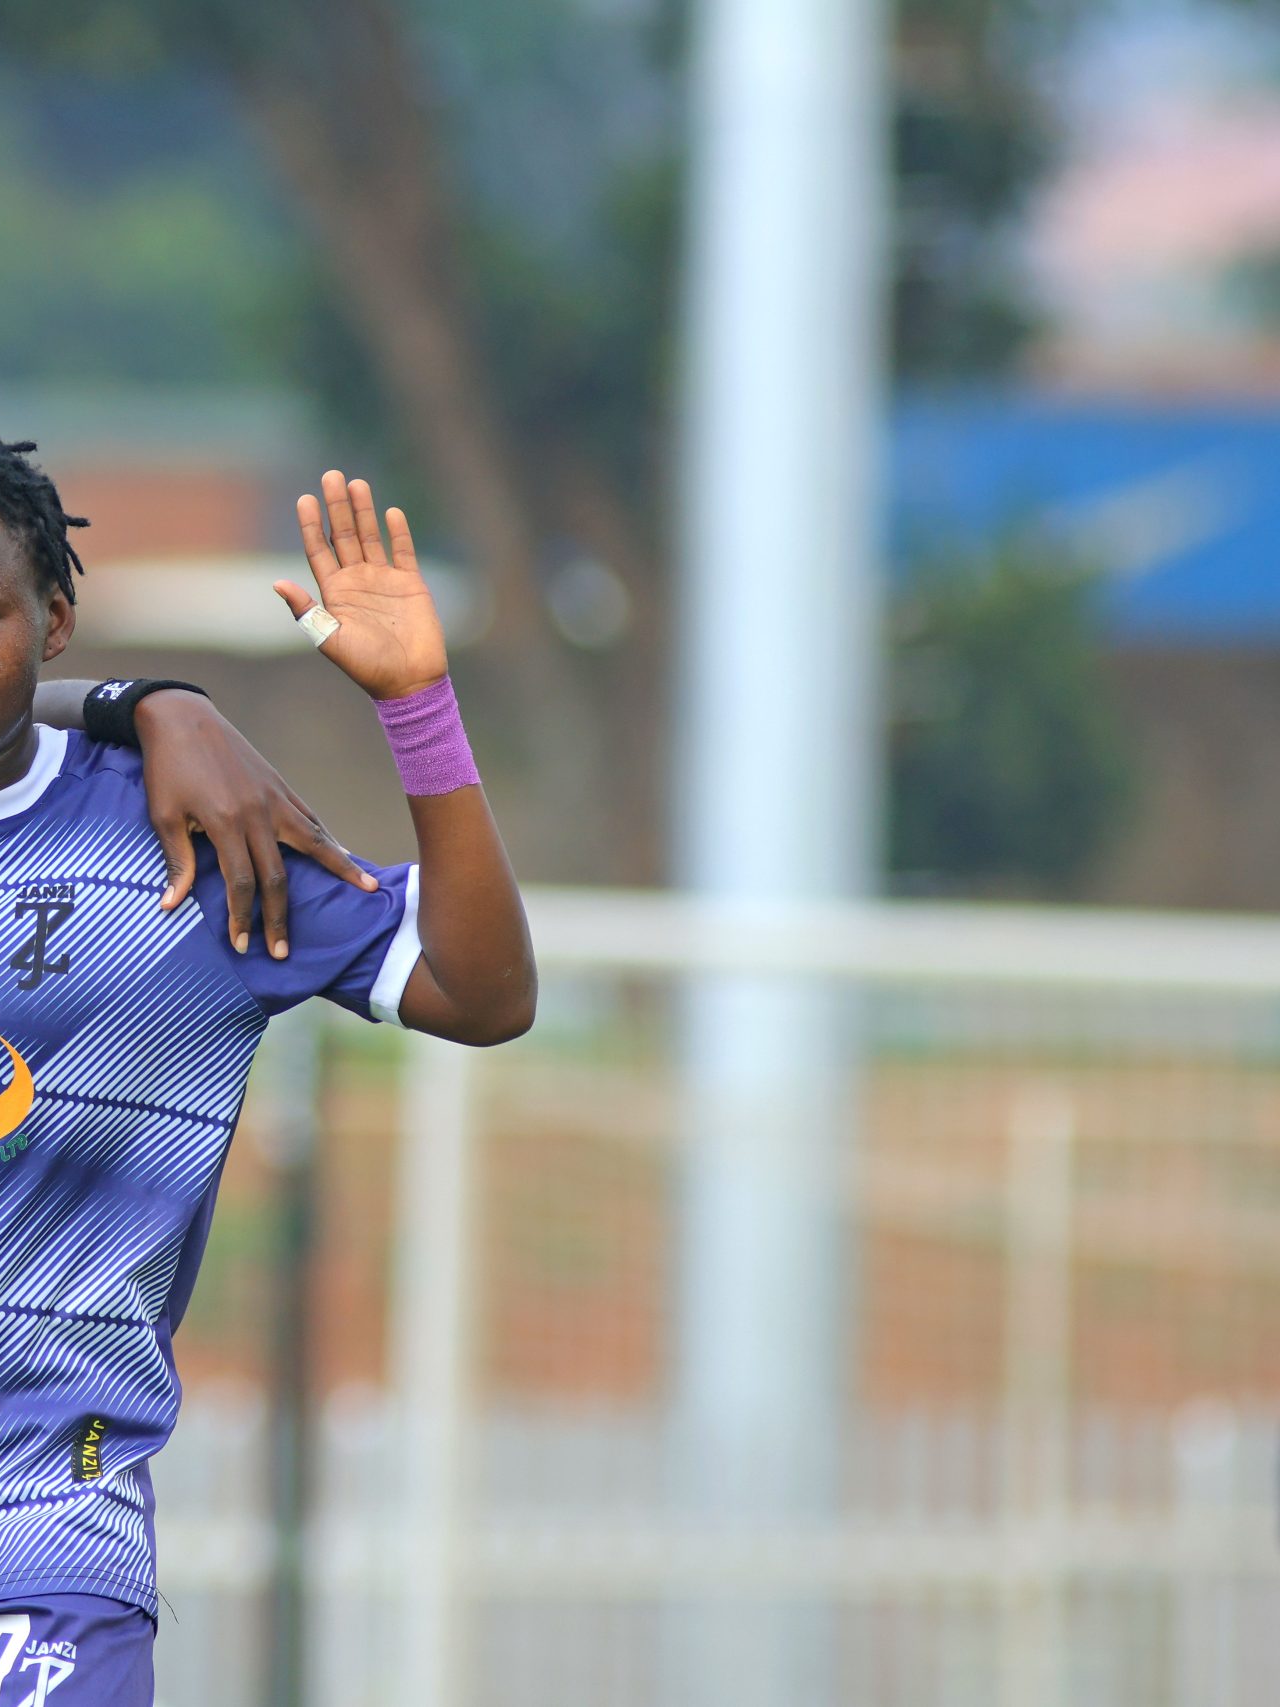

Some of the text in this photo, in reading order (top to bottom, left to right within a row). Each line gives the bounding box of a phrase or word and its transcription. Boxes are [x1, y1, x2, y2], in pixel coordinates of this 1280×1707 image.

[18, 886, 75, 899] JANZI
[0, 1134, 28, 1162] LTD
[82, 1420, 104, 1471] JANZI
[26, 1639, 77, 1659] JANZI
